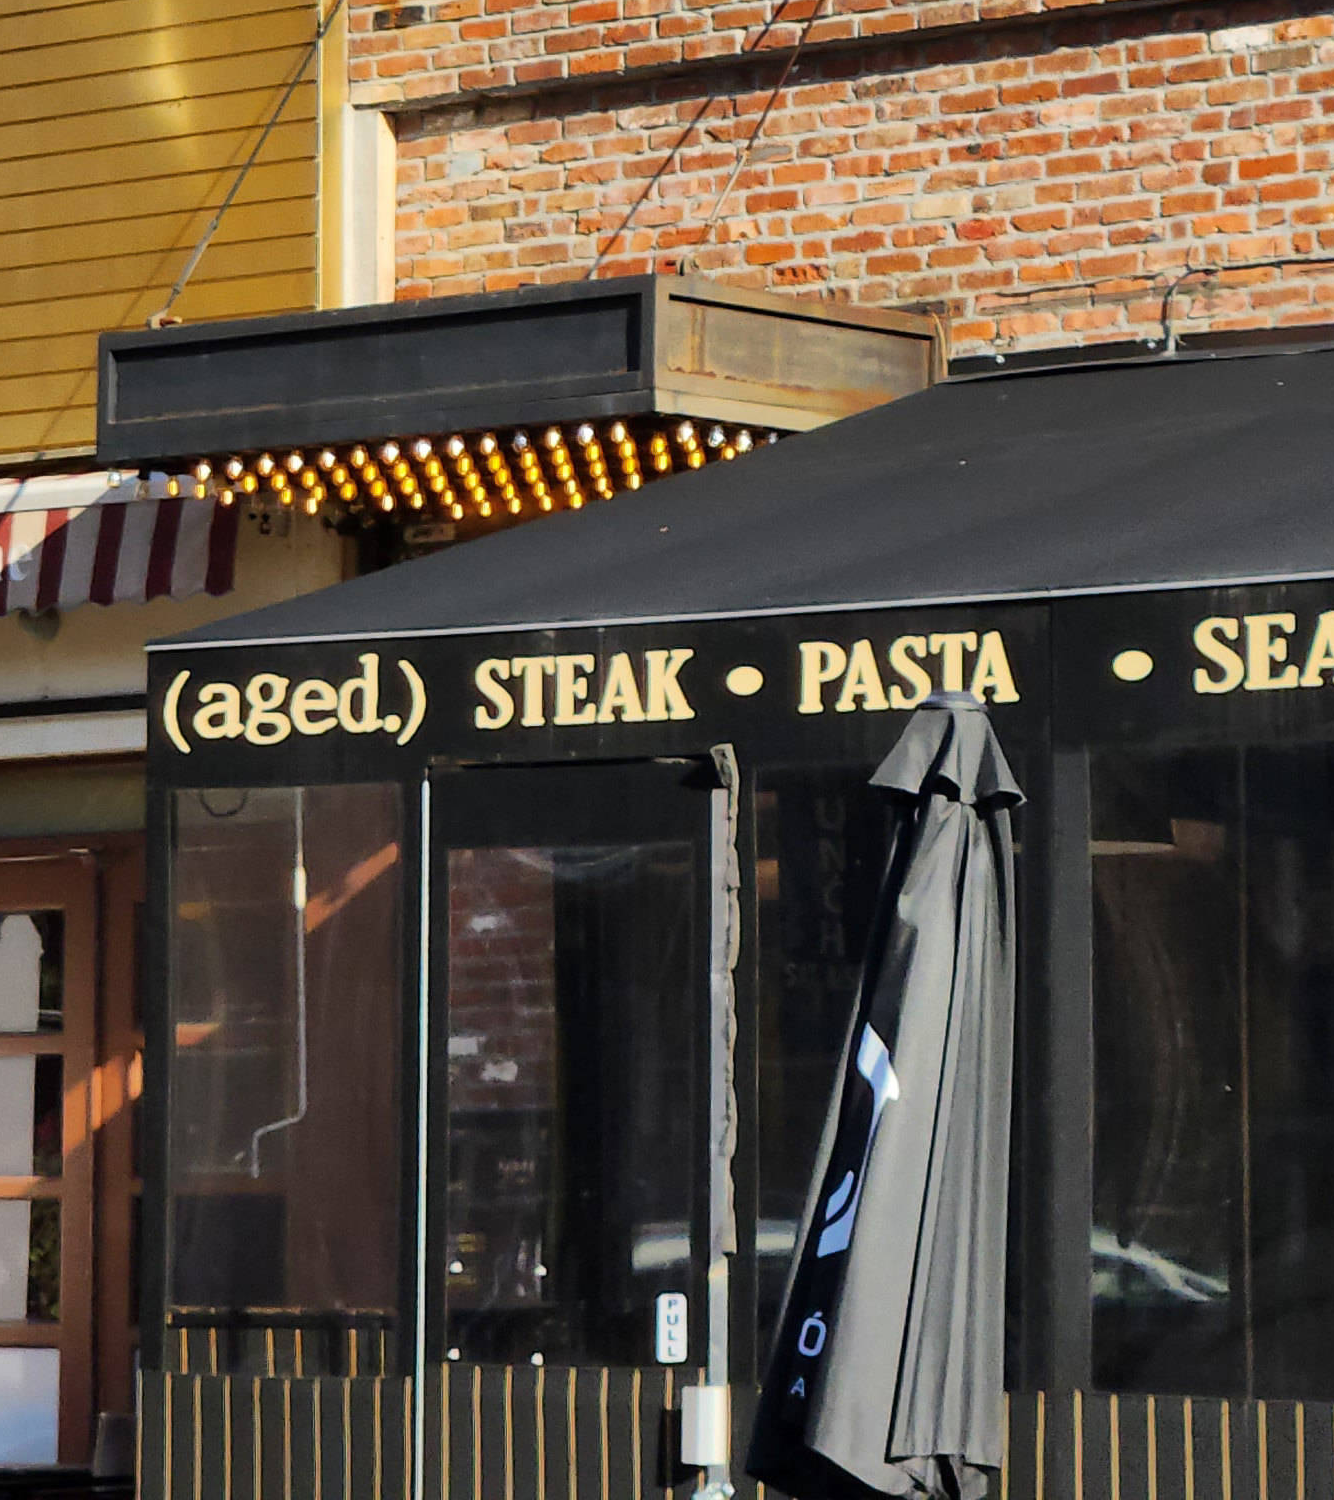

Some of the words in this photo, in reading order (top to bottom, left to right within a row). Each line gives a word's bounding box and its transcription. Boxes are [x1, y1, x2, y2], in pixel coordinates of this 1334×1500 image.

[164, 652, 427, 754] (aged.)
[475, 648, 695, 730] STEAK
[798, 631, 1020, 714] PASTA
[666, 1299, 679, 1357] PULL
